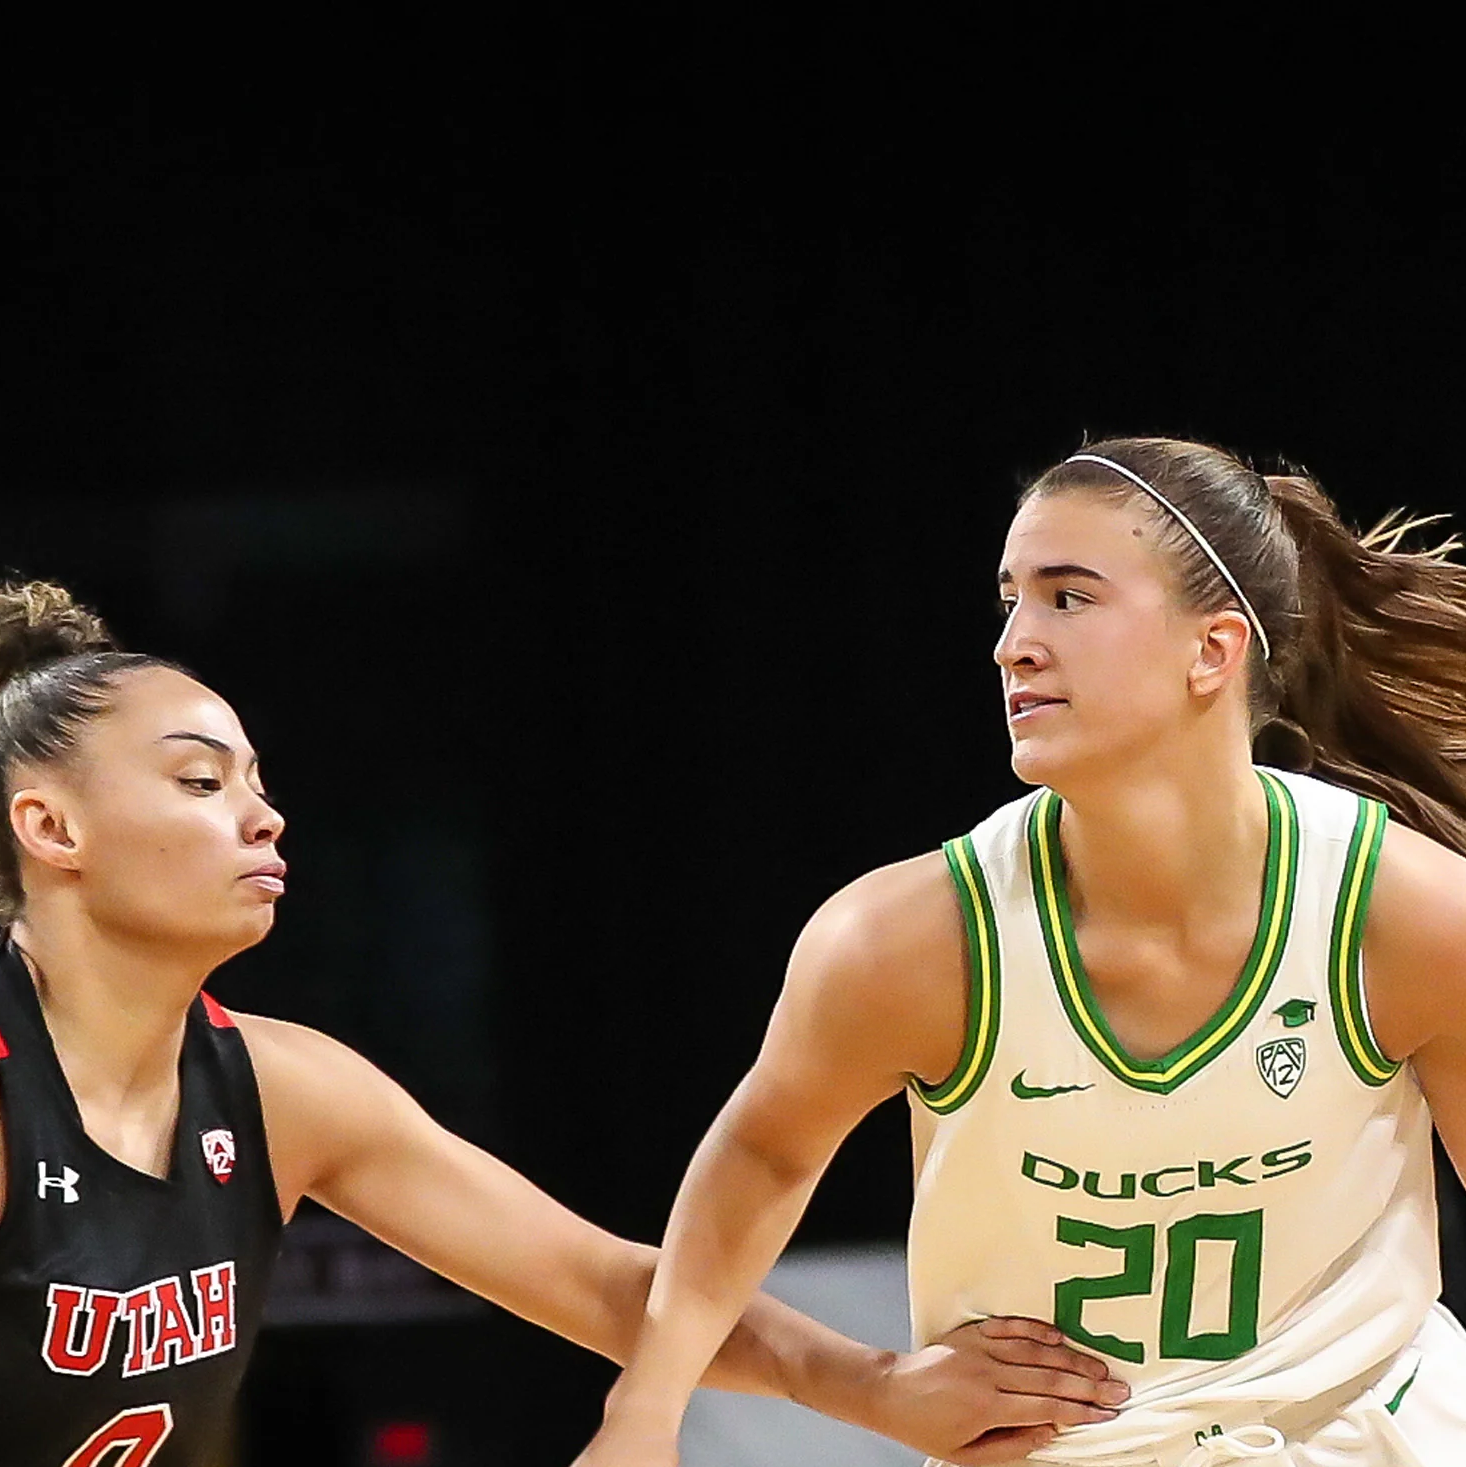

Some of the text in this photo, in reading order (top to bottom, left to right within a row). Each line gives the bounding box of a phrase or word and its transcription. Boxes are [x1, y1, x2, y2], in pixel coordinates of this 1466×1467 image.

[1261, 1041, 1302, 1078] PAC
[1271, 1063, 1294, 1087] 12
[1021, 1140, 1313, 1200] DUCKS
[1053, 1208, 1264, 1364] 20
[42, 1261, 236, 1377] UTAH
